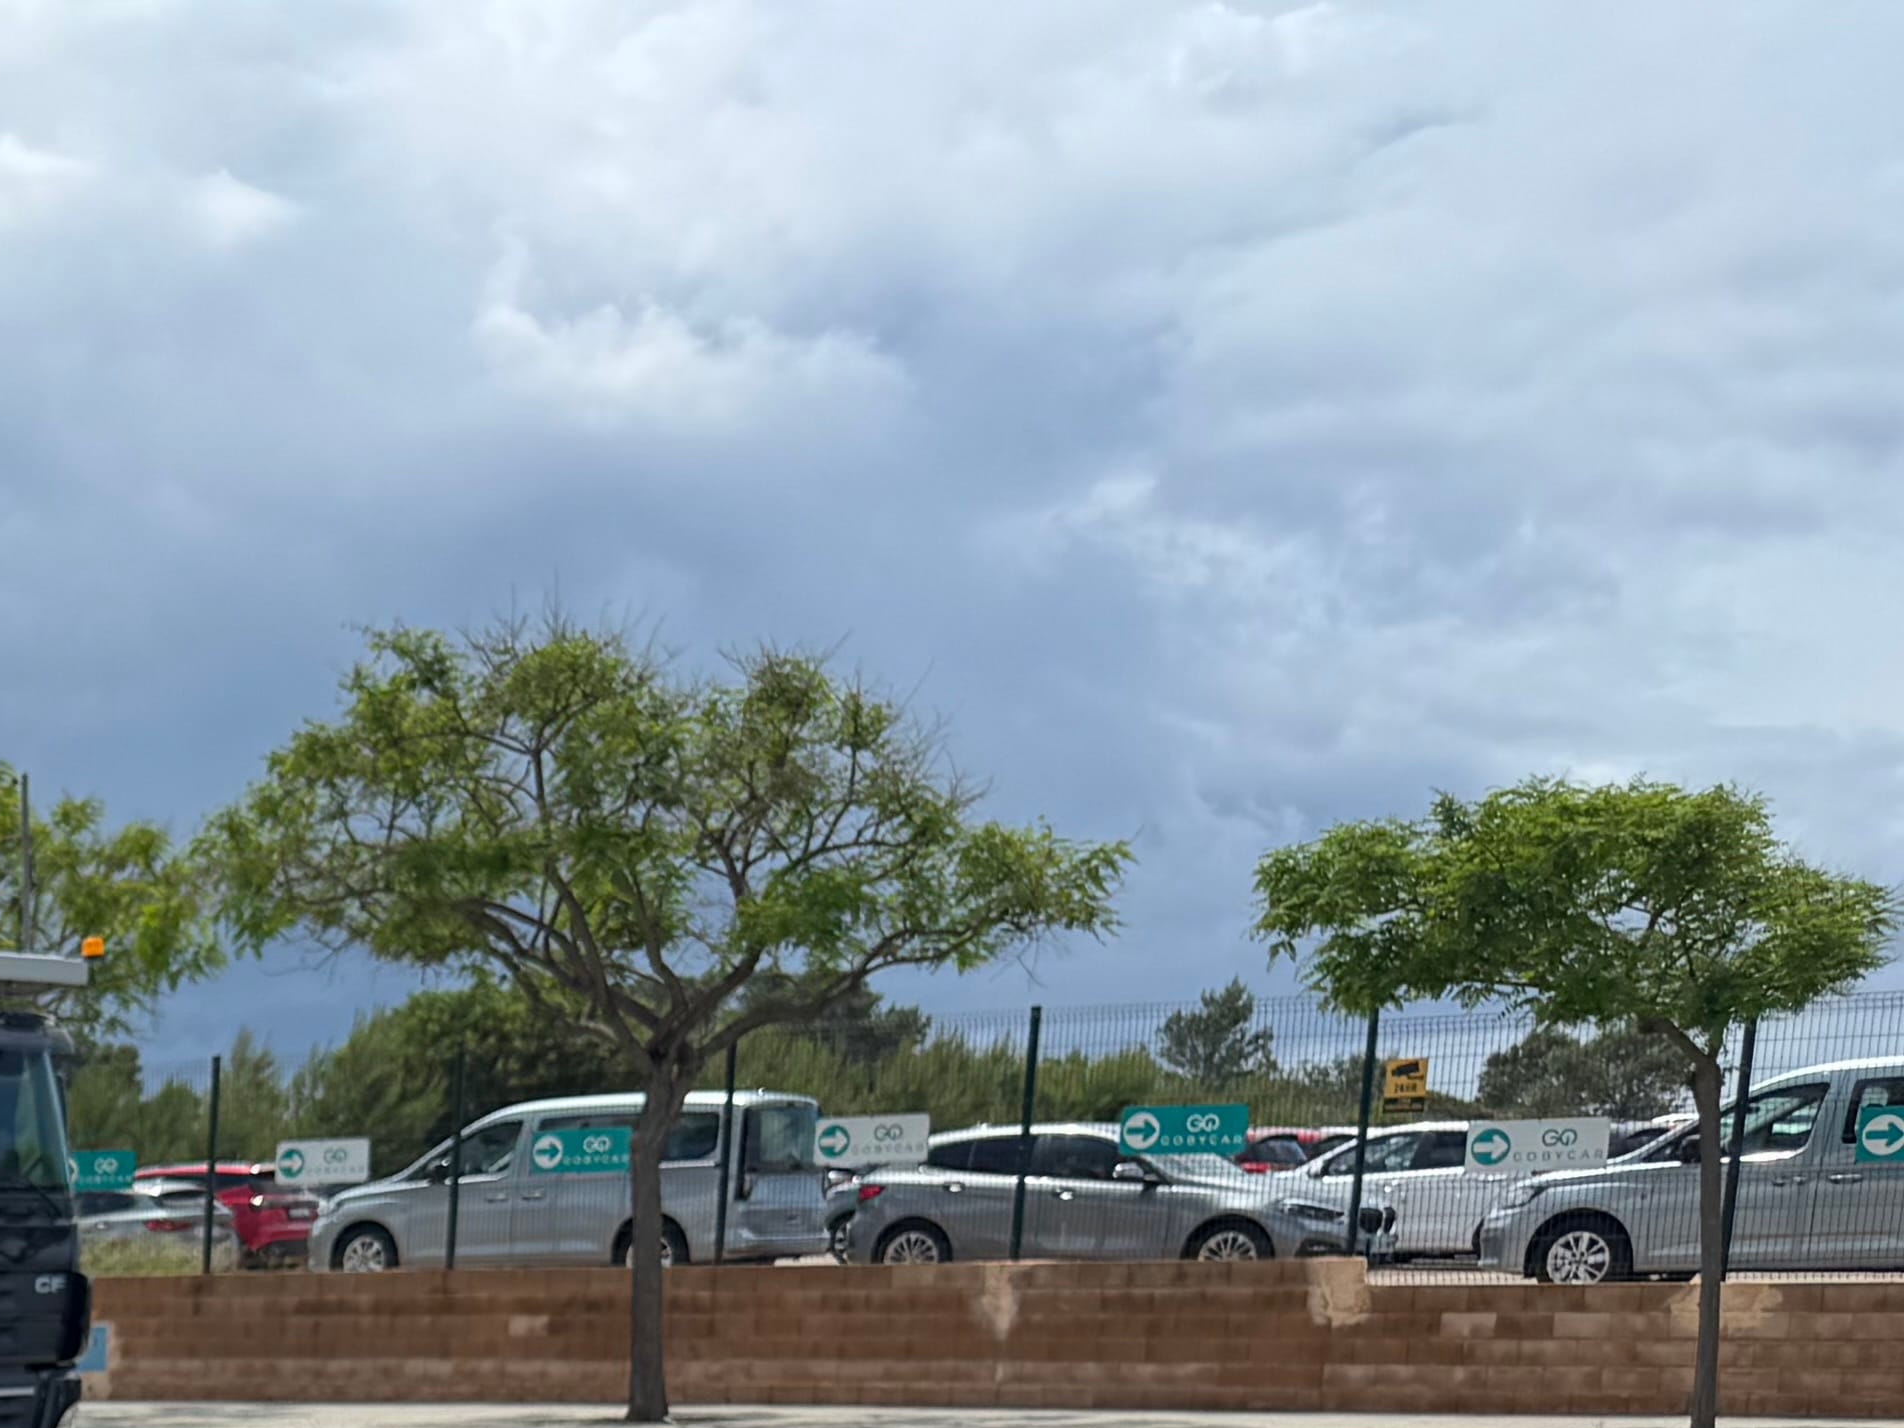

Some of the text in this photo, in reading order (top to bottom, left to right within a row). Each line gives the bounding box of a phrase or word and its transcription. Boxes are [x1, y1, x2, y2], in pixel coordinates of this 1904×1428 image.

[1160, 1134, 1243, 1147] GOBYCAR
[1513, 1148, 1604, 1163] GOBYCAR
[34, 1275, 67, 1293] CF
